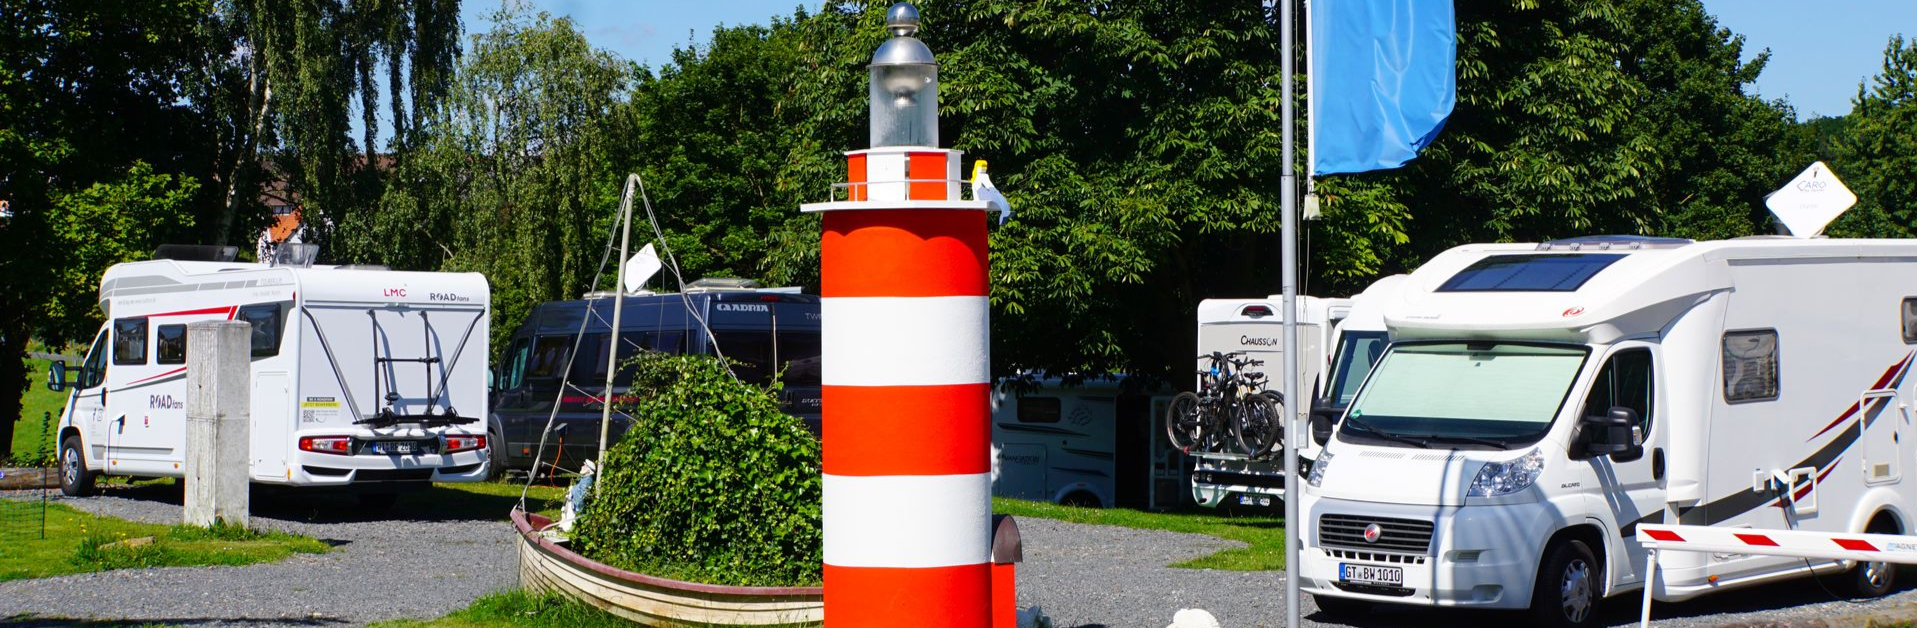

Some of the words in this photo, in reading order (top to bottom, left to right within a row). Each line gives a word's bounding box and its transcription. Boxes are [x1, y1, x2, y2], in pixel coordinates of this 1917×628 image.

[384, 289, 406, 297] LMC
[732, 303, 768, 312] ADRIA
[805, 312, 822, 320] TWI
[1345, 566, 1357, 578] GT
[1363, 567, 1376, 580] BW
[1377, 568, 1400, 582] 1010
